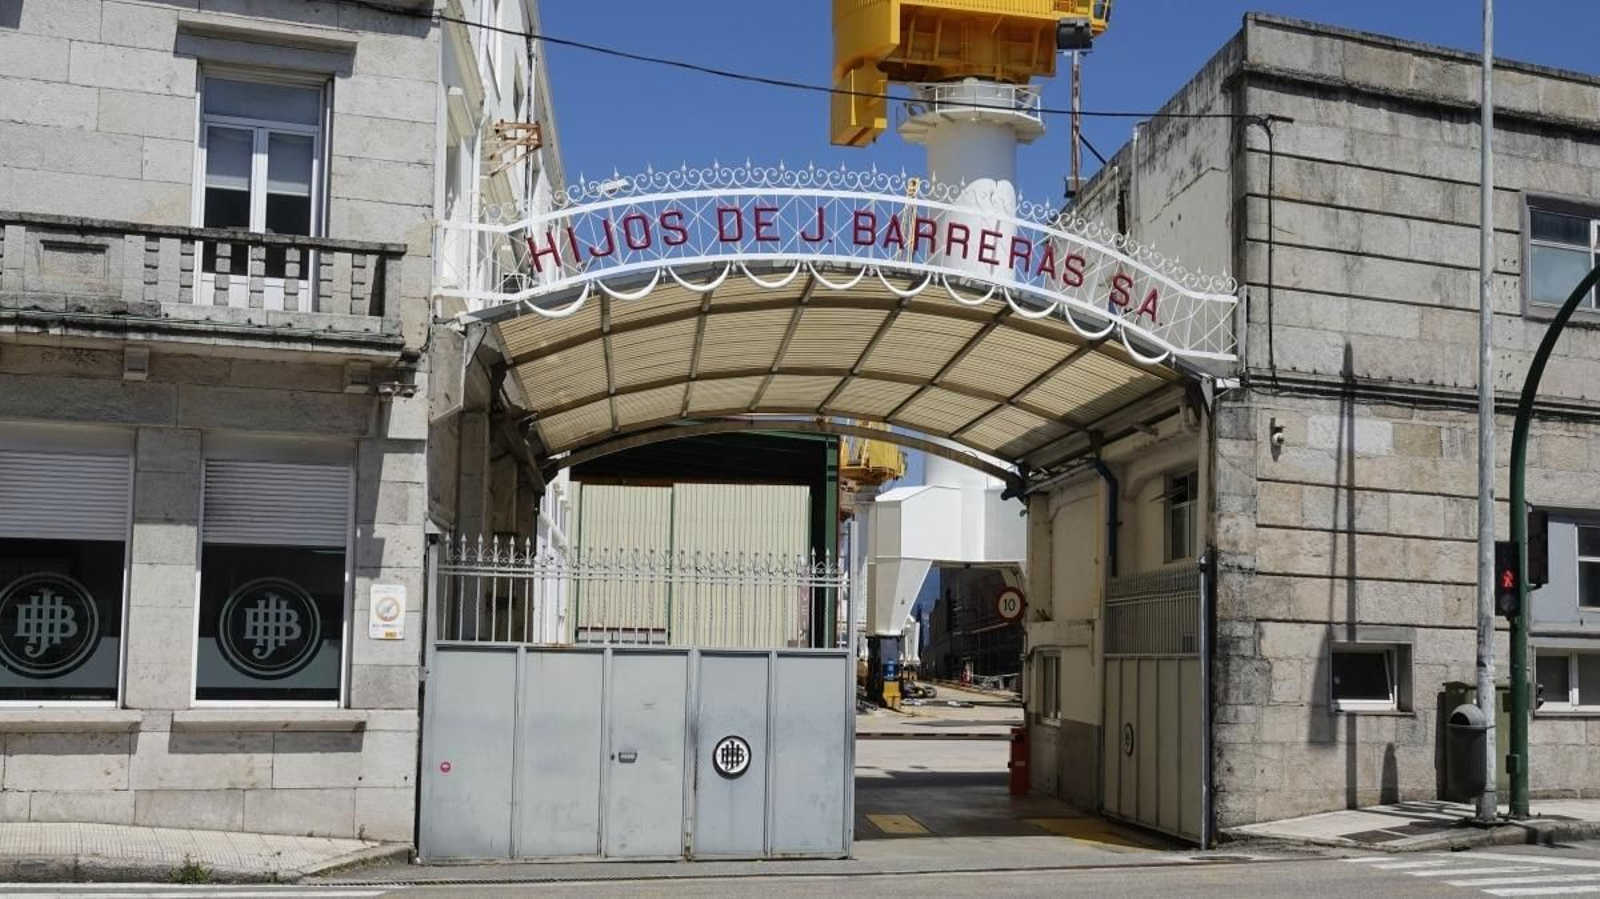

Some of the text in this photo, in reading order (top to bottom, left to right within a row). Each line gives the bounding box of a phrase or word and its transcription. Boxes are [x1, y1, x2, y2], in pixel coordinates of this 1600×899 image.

[526, 207, 689, 273] HIJOS
[716, 205, 781, 243] DE
[851, 208, 1087, 289] BARRERAS
[1003, 598, 1017, 612] 10
